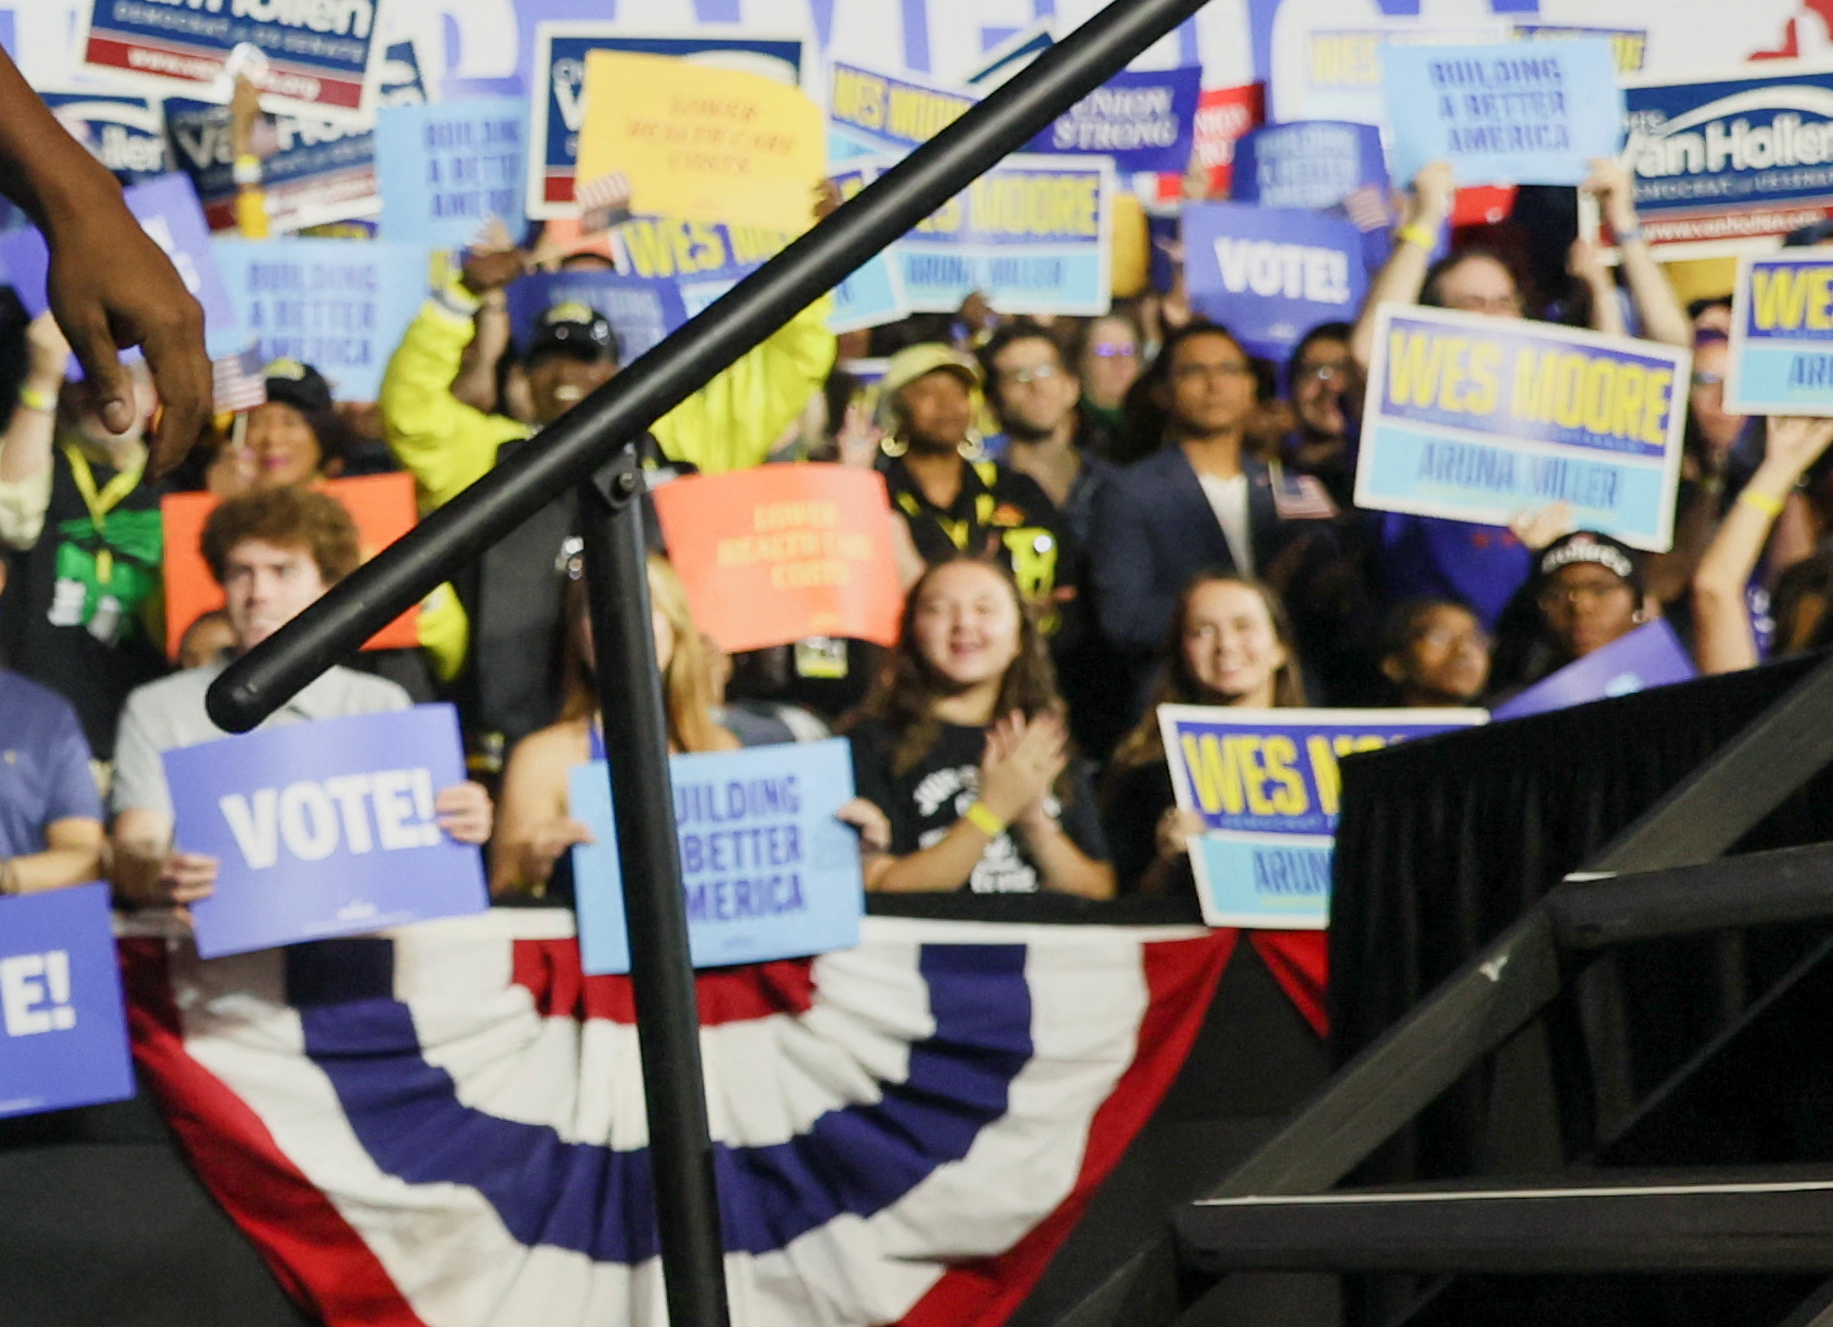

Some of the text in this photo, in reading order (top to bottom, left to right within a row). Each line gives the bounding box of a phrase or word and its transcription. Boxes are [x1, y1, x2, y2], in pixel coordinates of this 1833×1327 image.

[1431, 57, 1562, 84] BUILDING
[1466, 90, 1566, 116] BETTER
[1448, 124, 1571, 153] AMERICA
[1213, 236, 1351, 304] VOTE!
[1753, 266, 1833, 331] WE
[1388, 330, 1503, 416] WES
[1509, 347, 1673, 447] MOORE
[1181, 731, 1309, 816] WES
[221, 768, 441, 870] VOTE!
[675, 775, 800, 823] UILDING
[684, 825, 801, 874] BETTER
[1254, 848, 1330, 894] ARUN
[684, 874, 805, 920] MERICA
